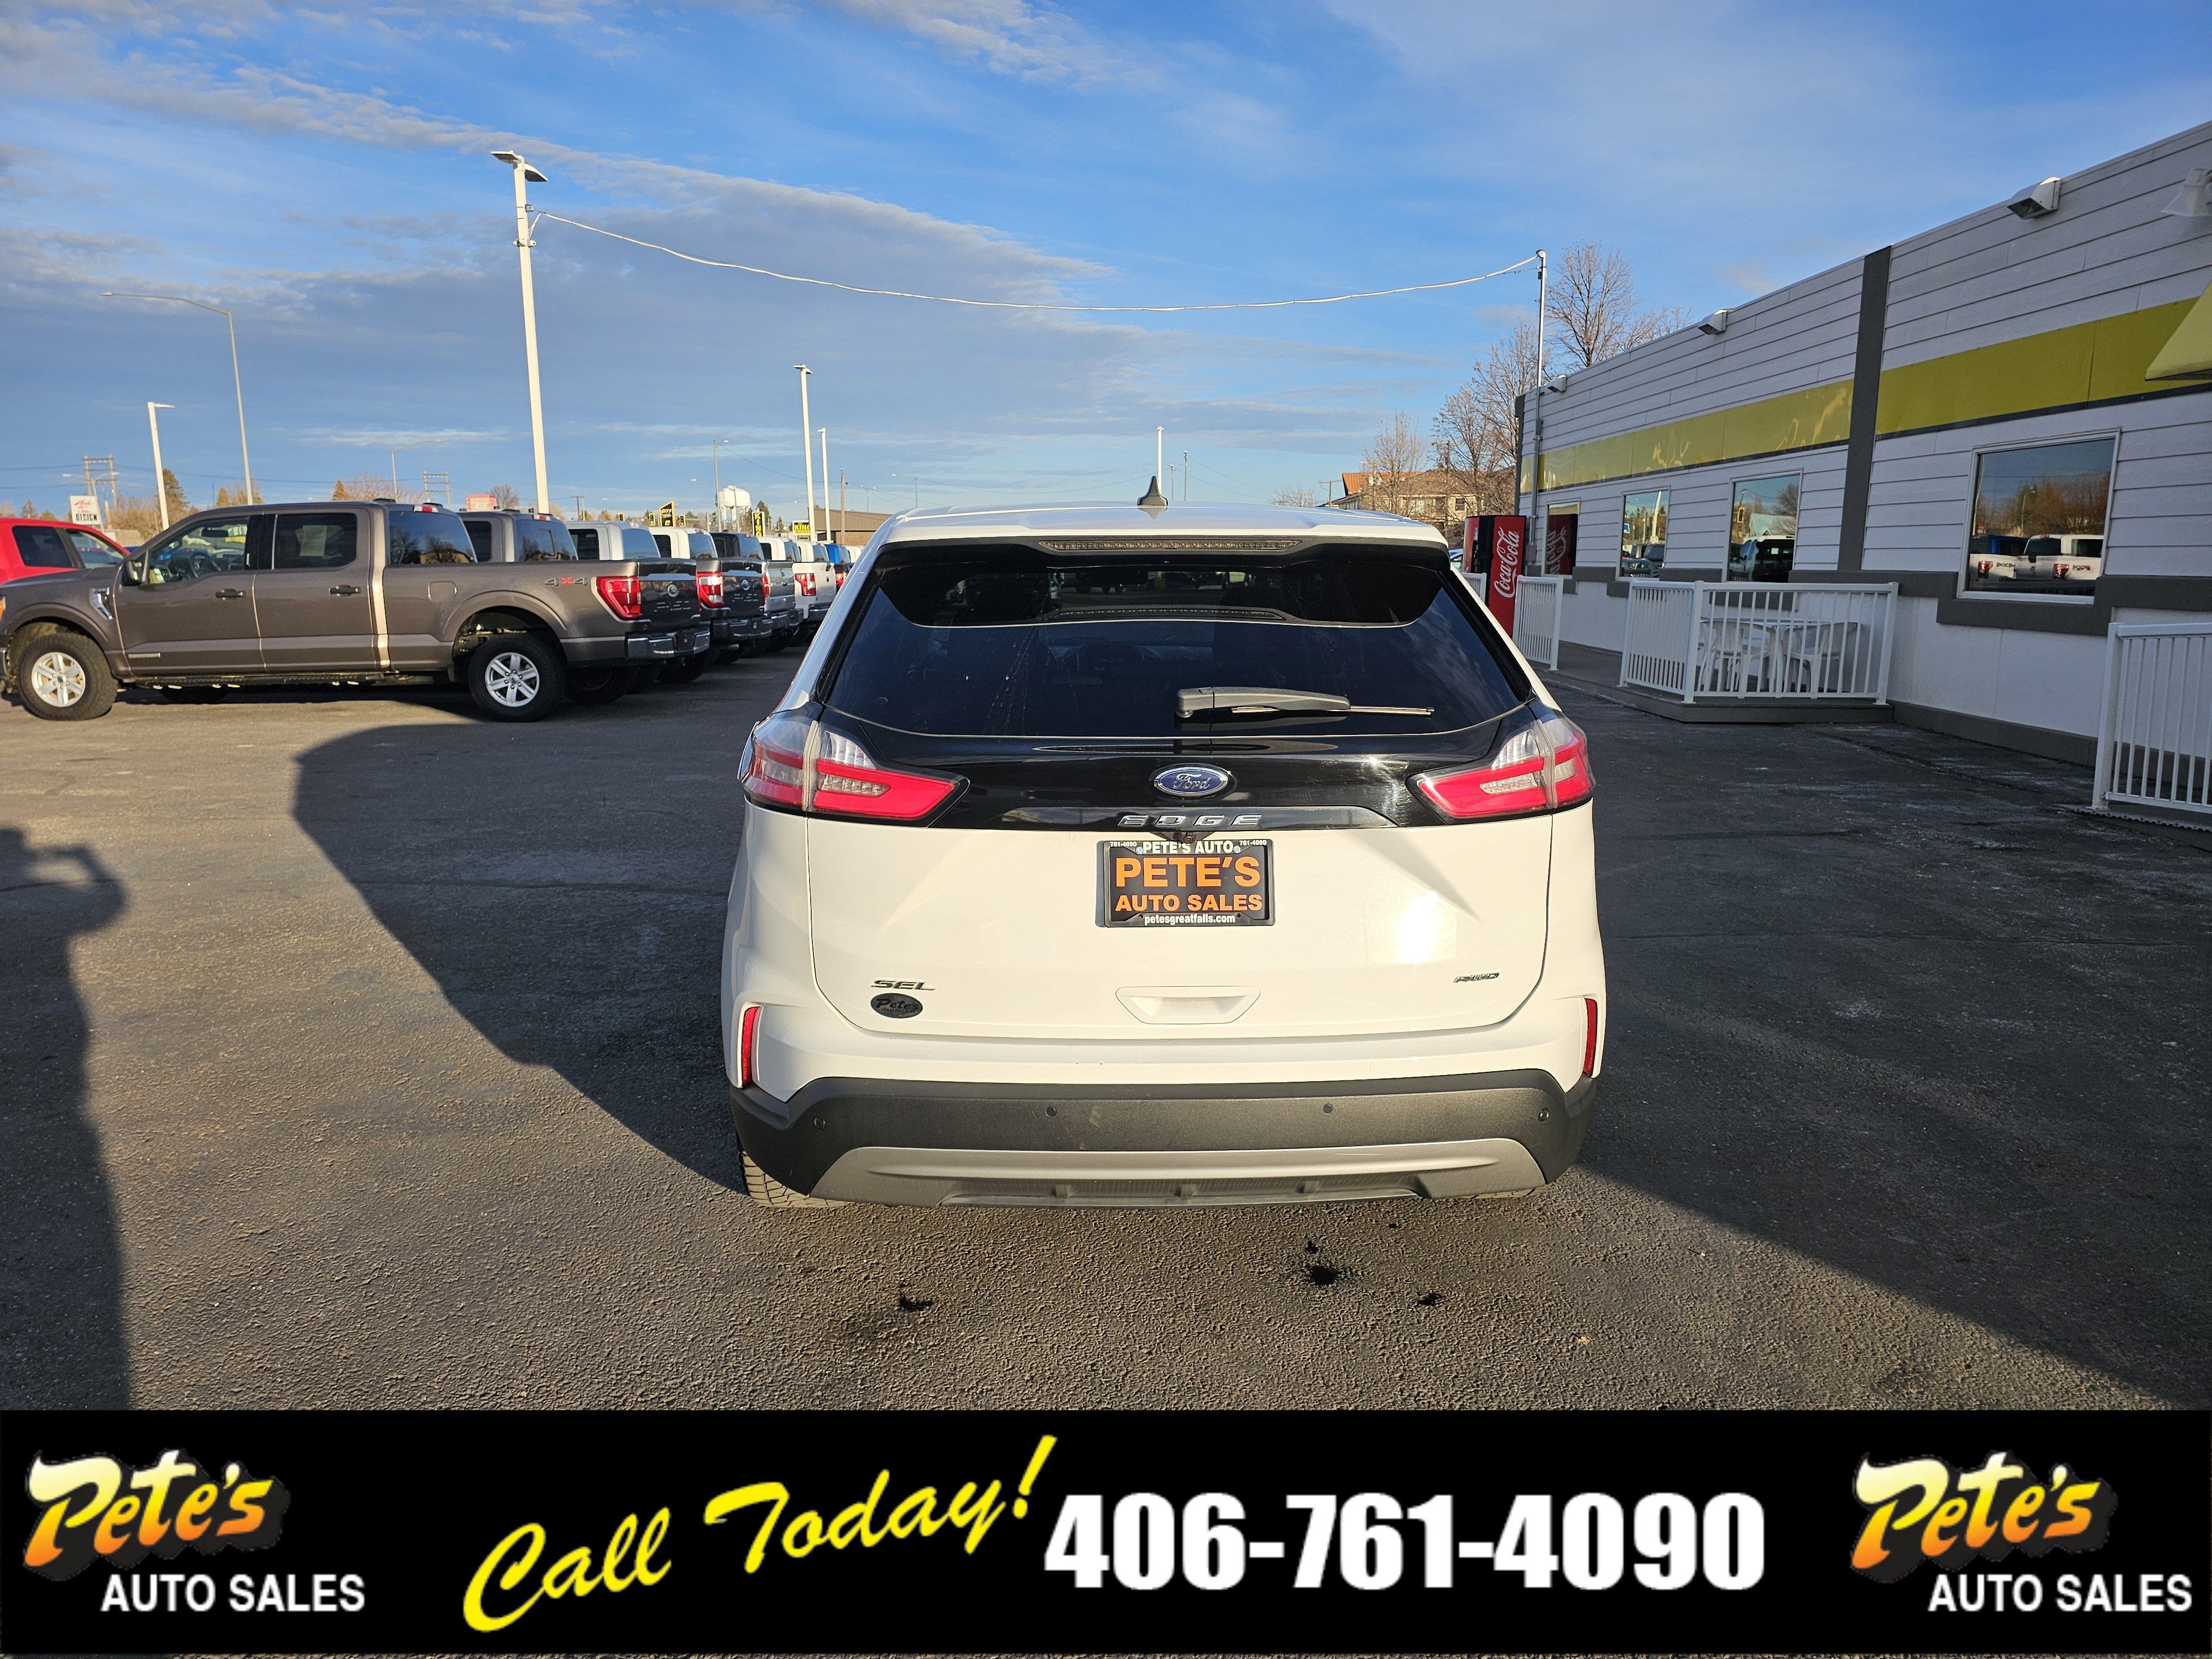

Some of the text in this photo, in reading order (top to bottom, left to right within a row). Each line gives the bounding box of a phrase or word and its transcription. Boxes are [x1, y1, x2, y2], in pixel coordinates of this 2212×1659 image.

[1494, 526, 1520, 598] Coca-Cola
[1172, 773, 1211, 791] Ford
[1117, 815, 1262, 827] EDGE
[1142, 841, 1234, 854] PETE'S AUTO
[1116, 857, 1260, 887] PETE'S
[1115, 894, 1262, 912] AUTO SALES
[1144, 914, 1235, 926] petesgreatfalls.com
[1453, 972, 1500, 983] AWD
[870, 980, 936, 990] SEL
[876, 998, 919, 1010] Pete's
